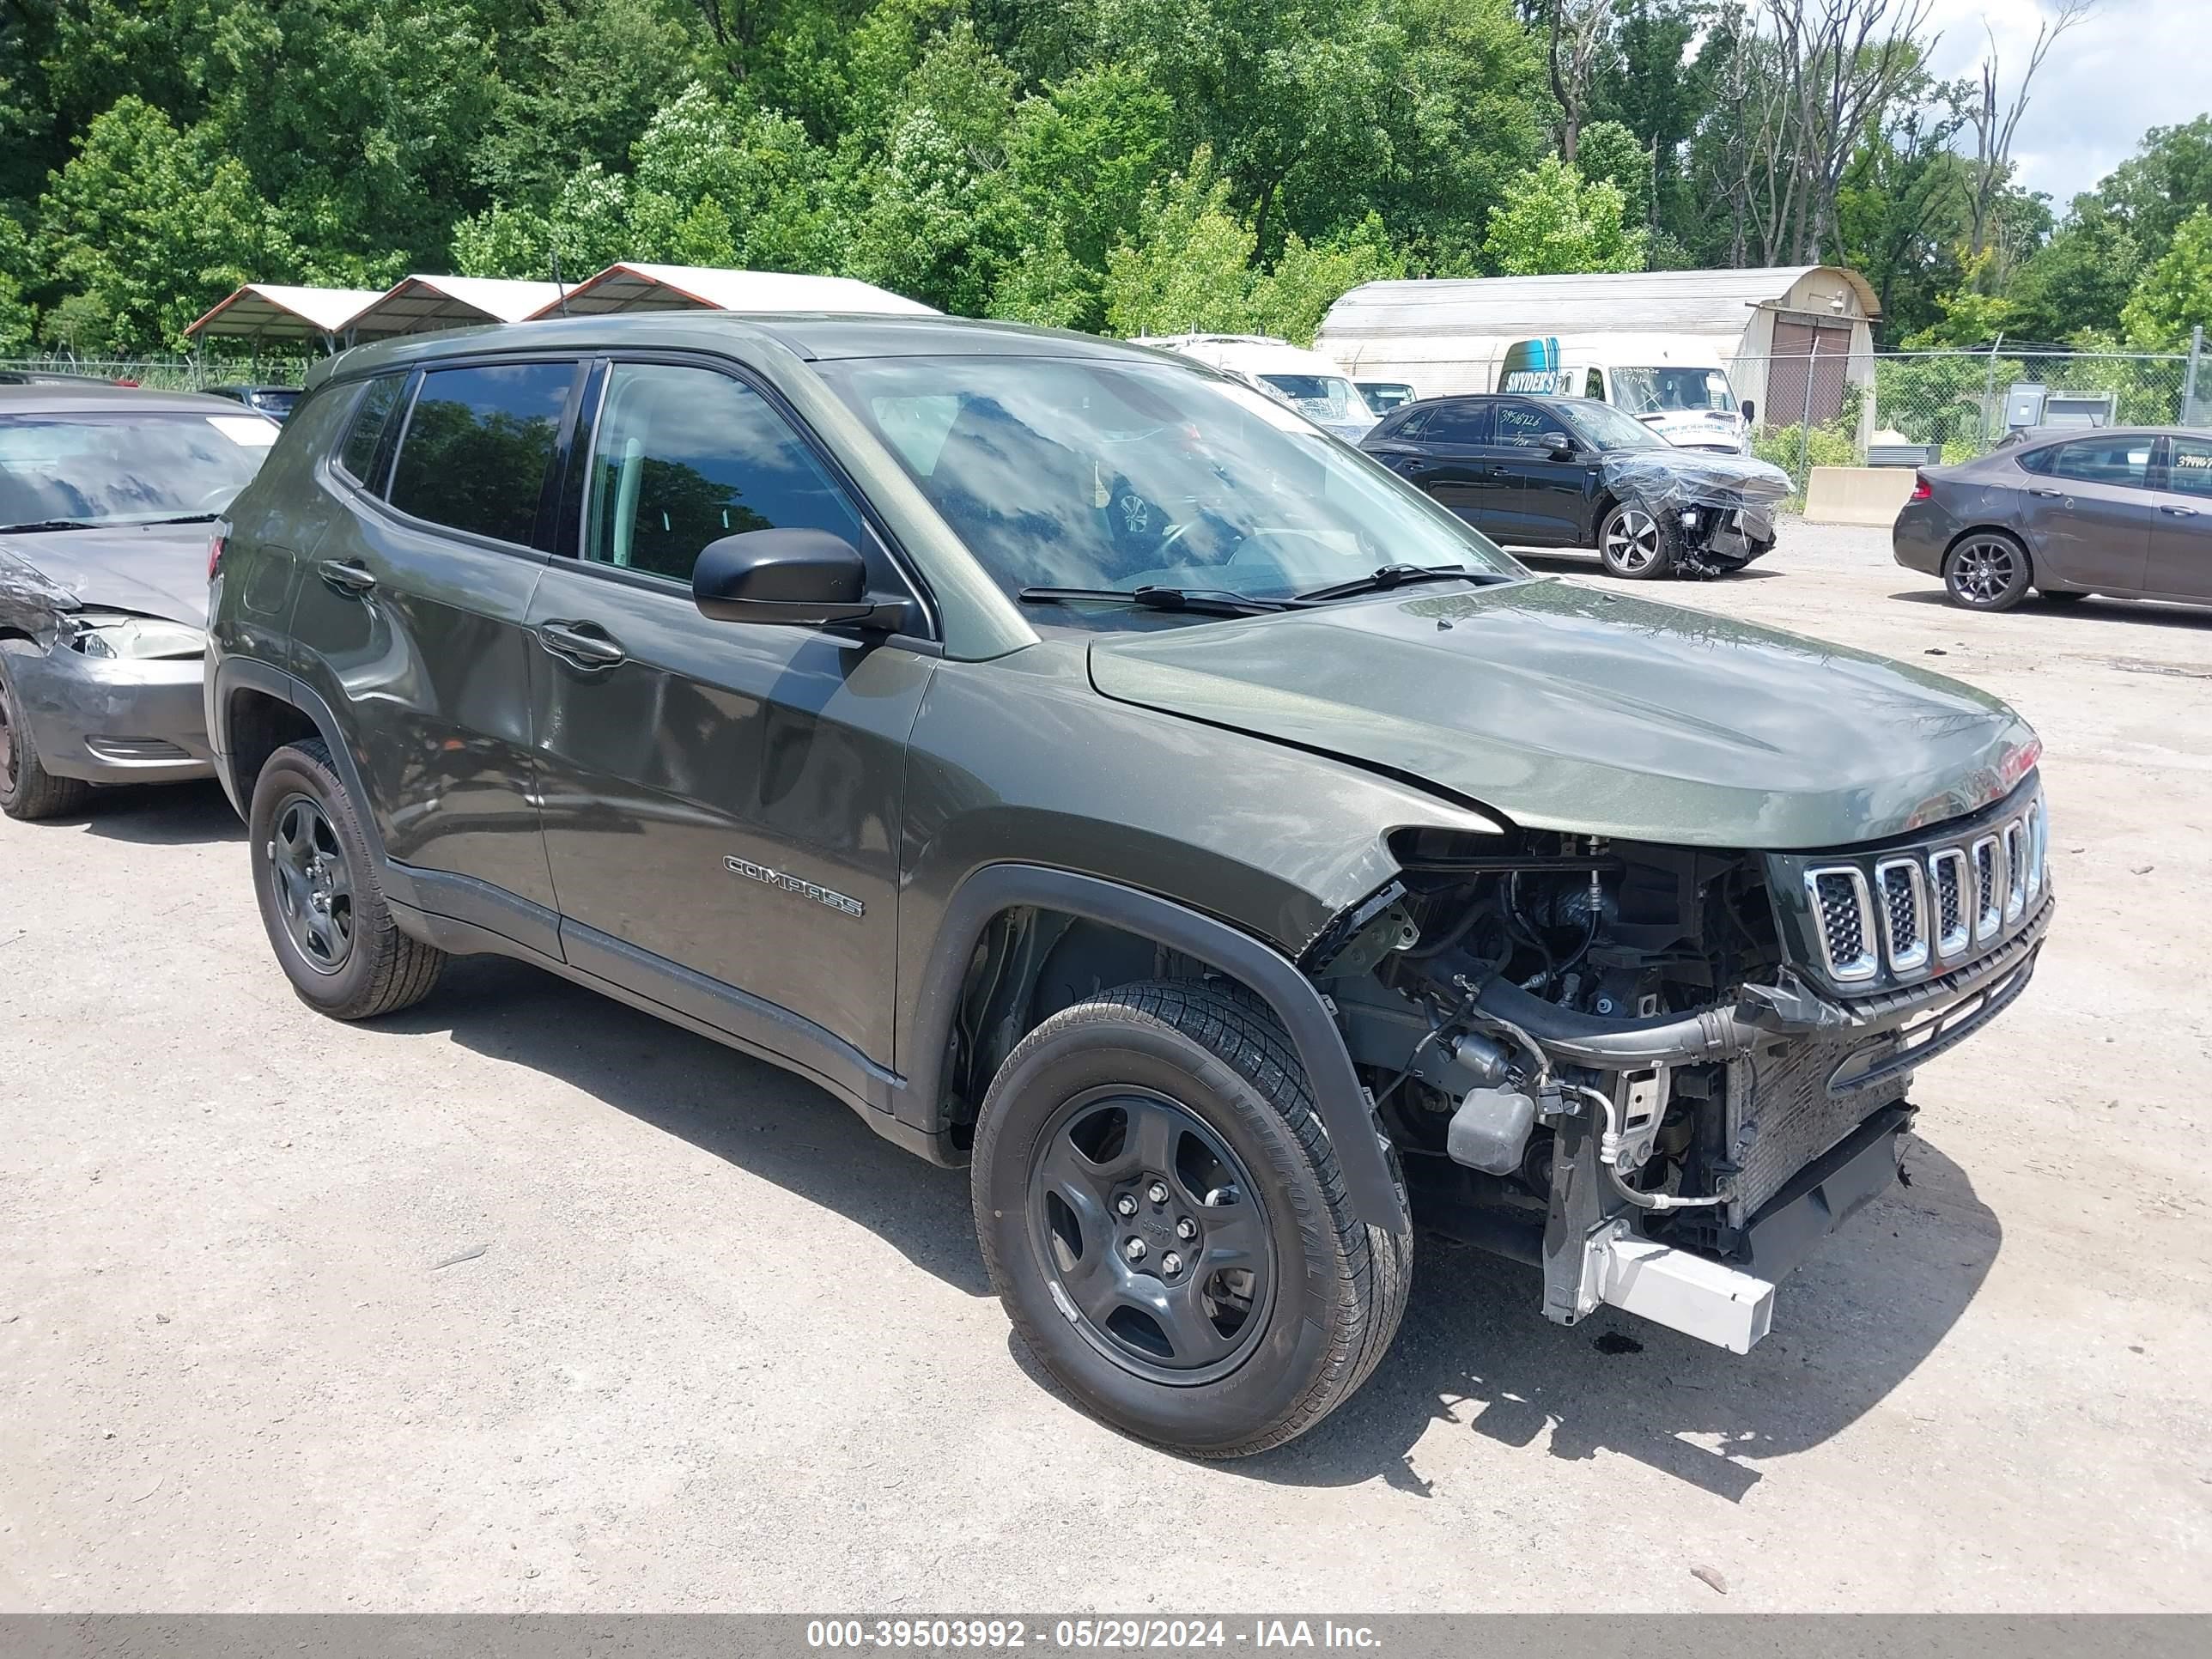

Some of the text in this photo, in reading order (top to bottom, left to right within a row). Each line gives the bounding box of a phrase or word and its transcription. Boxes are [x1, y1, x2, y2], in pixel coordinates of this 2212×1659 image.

[1506, 371, 1557, 392] SNYDER'S
[1499, 410, 1542, 427] 39516726
[723, 855, 865, 917] COMPASS
